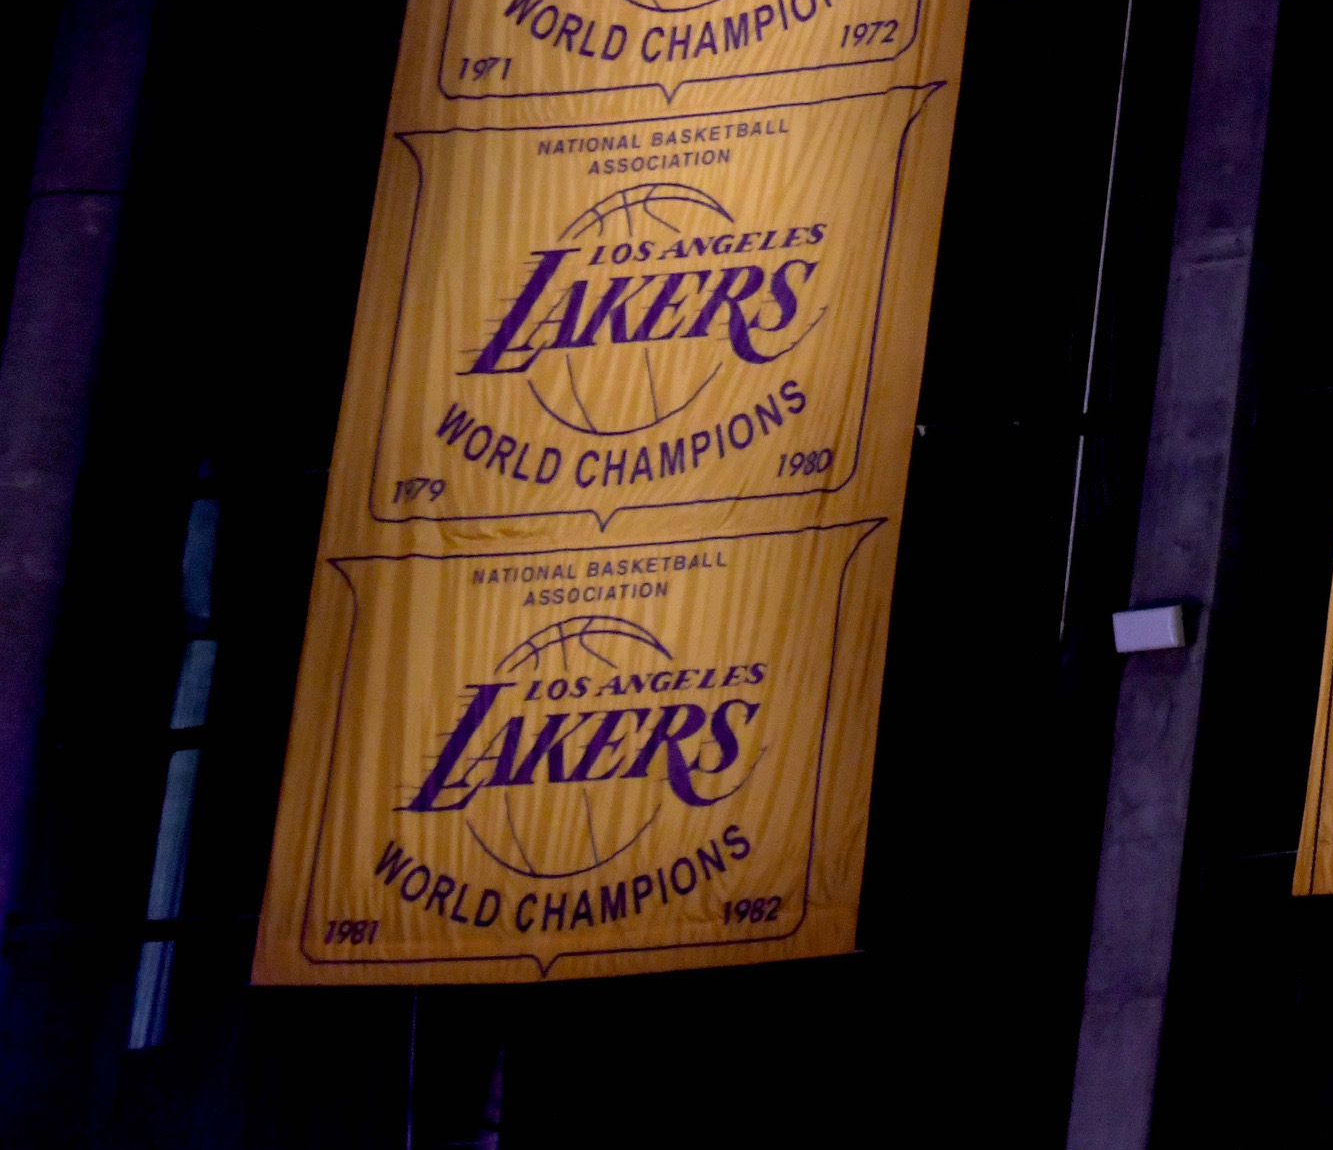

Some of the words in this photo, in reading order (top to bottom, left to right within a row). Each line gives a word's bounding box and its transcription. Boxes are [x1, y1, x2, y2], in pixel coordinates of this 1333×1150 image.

[840, 20, 898, 48] 1972
[458, 58, 510, 80] 1971
[538, 134, 642, 155] NATIONAL
[652, 119, 789, 147] BASKETBALL
[588, 149, 730, 175] ASSOCIATION
[589, 245, 651, 266] LOS
[659, 223, 827, 261] ANGELES
[456, 248, 818, 376] LAKERS
[436, 402, 562, 486] WORLD
[575, 379, 806, 487] CHAMPIONS
[777, 449, 832, 477] 1980
[472, 563, 576, 585] NATIONAL
[587, 551, 727, 578] BASKETBALL
[523, 582, 668, 607] ASSOCIATION
[525, 676, 587, 701] LOS
[595, 663, 768, 696] ANGELES
[393, 683, 760, 812] LAKERS
[374, 840, 501, 928] WORLD
[516, 825, 751, 932] CHAMPIONS
[724, 897, 781, 923] 1982
[325, 921, 379, 944] 1981
